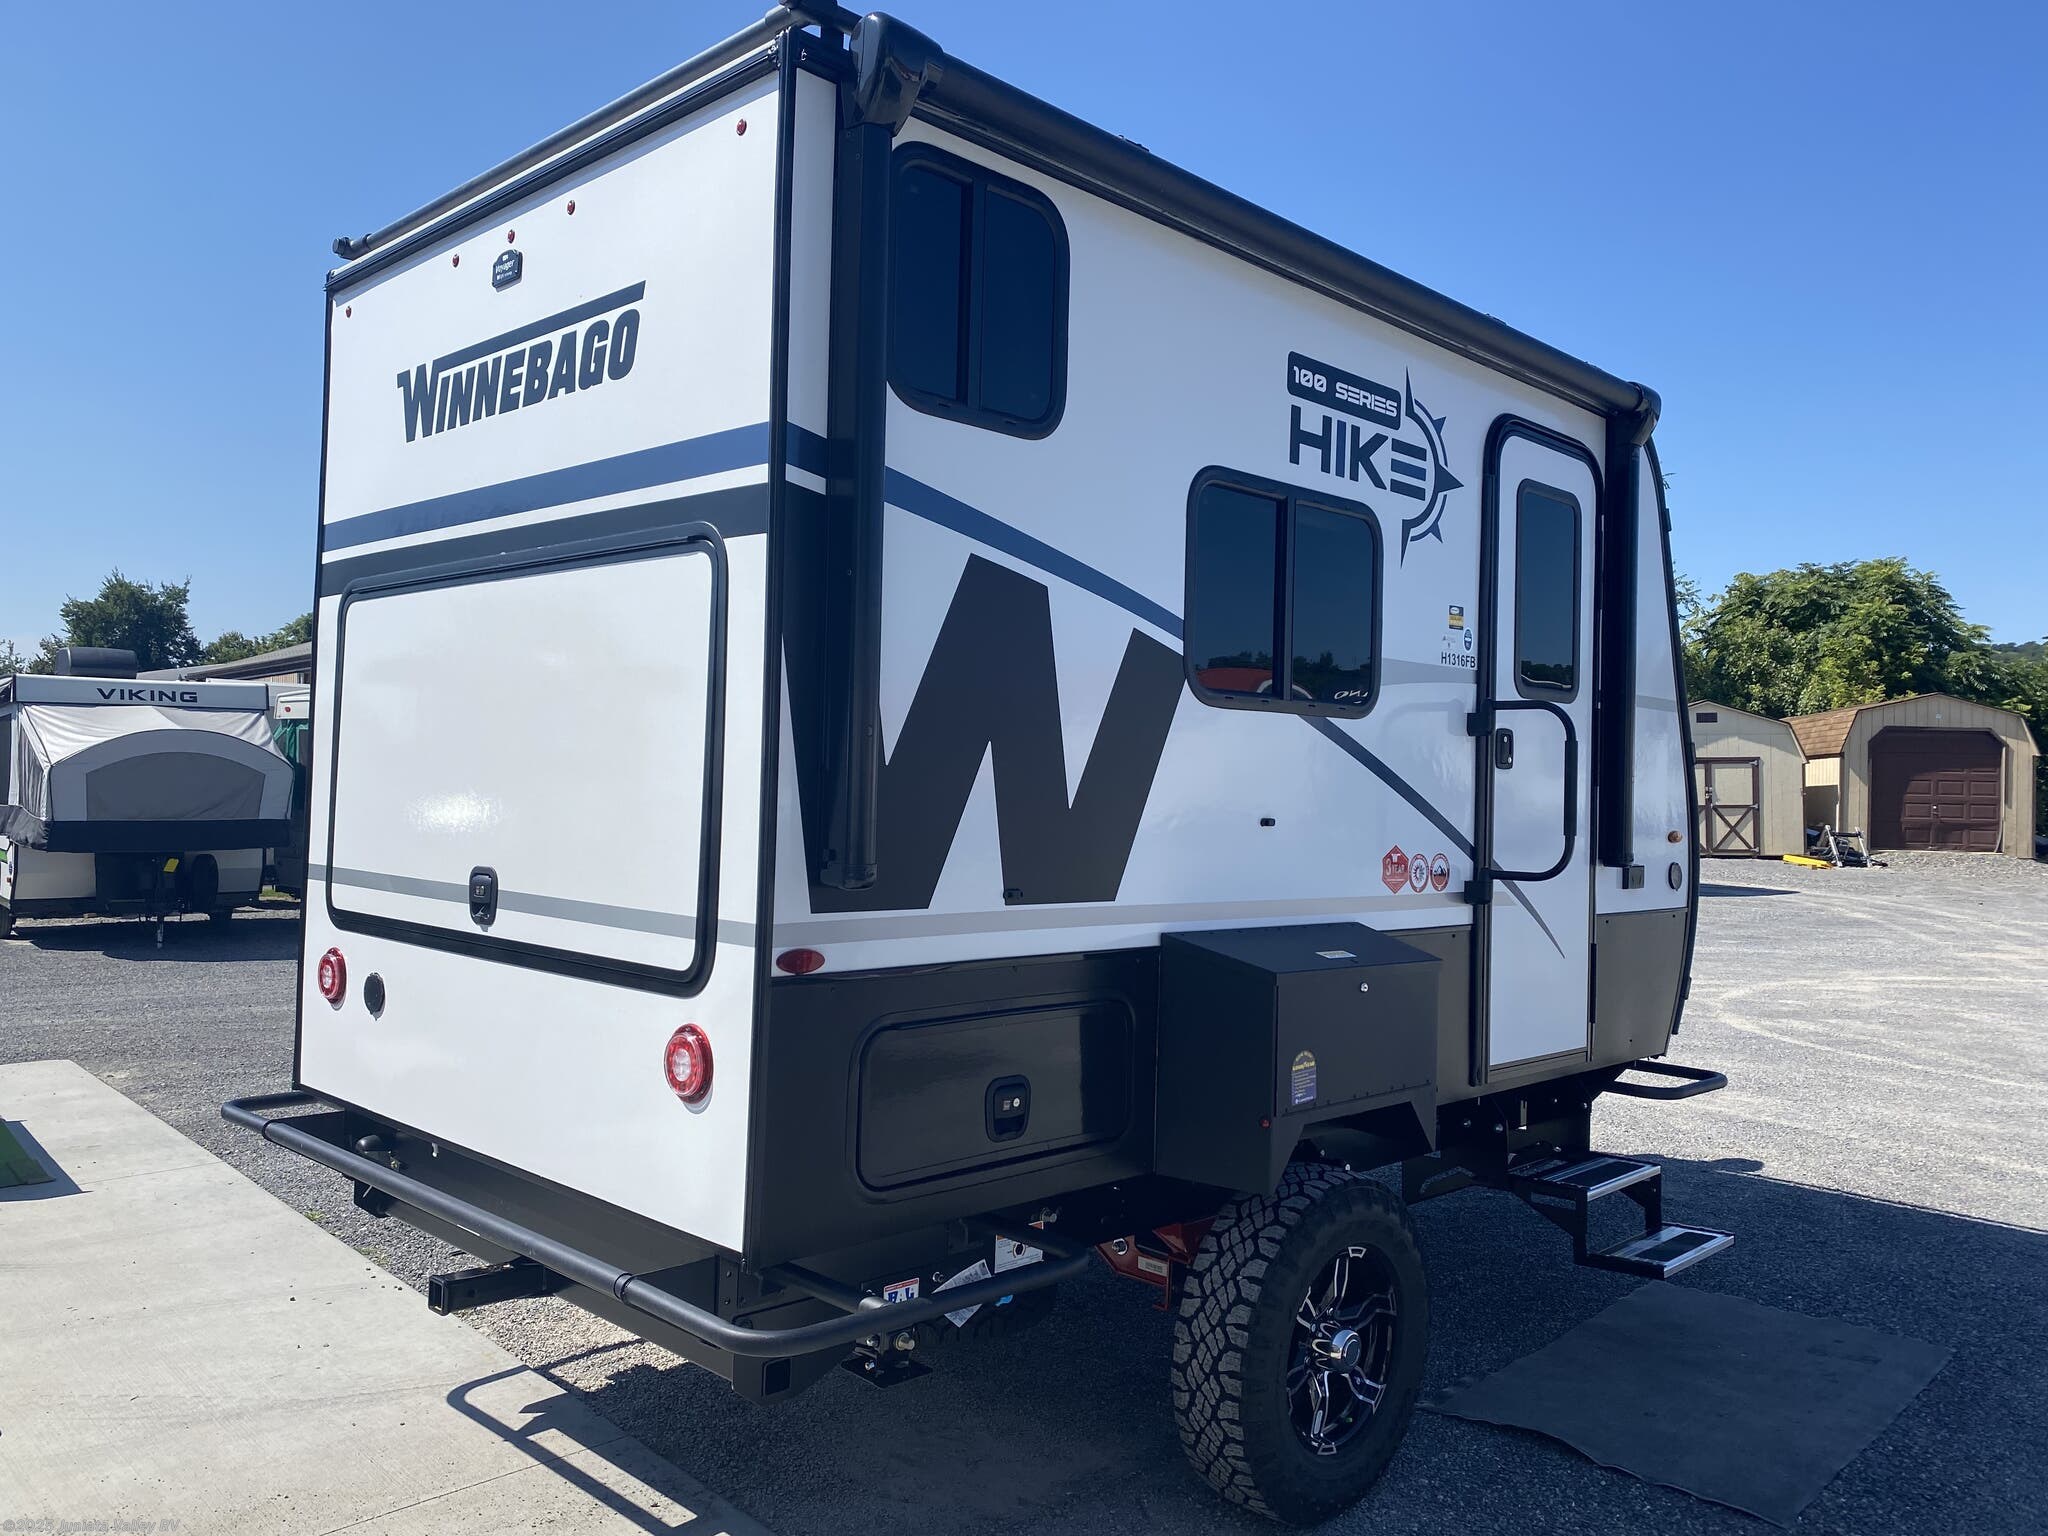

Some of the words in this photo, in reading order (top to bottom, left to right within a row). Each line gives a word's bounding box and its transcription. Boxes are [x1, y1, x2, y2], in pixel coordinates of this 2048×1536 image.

[397, 306, 642, 443] WINNEBAGO
[1293, 365, 1328, 393] 100
[1335, 381, 1399, 418] SERIES
[1289, 404, 1427, 502] HIKE
[1441, 651, 1476, 669] H1316FB
[96, 687, 199, 703] VIKING
